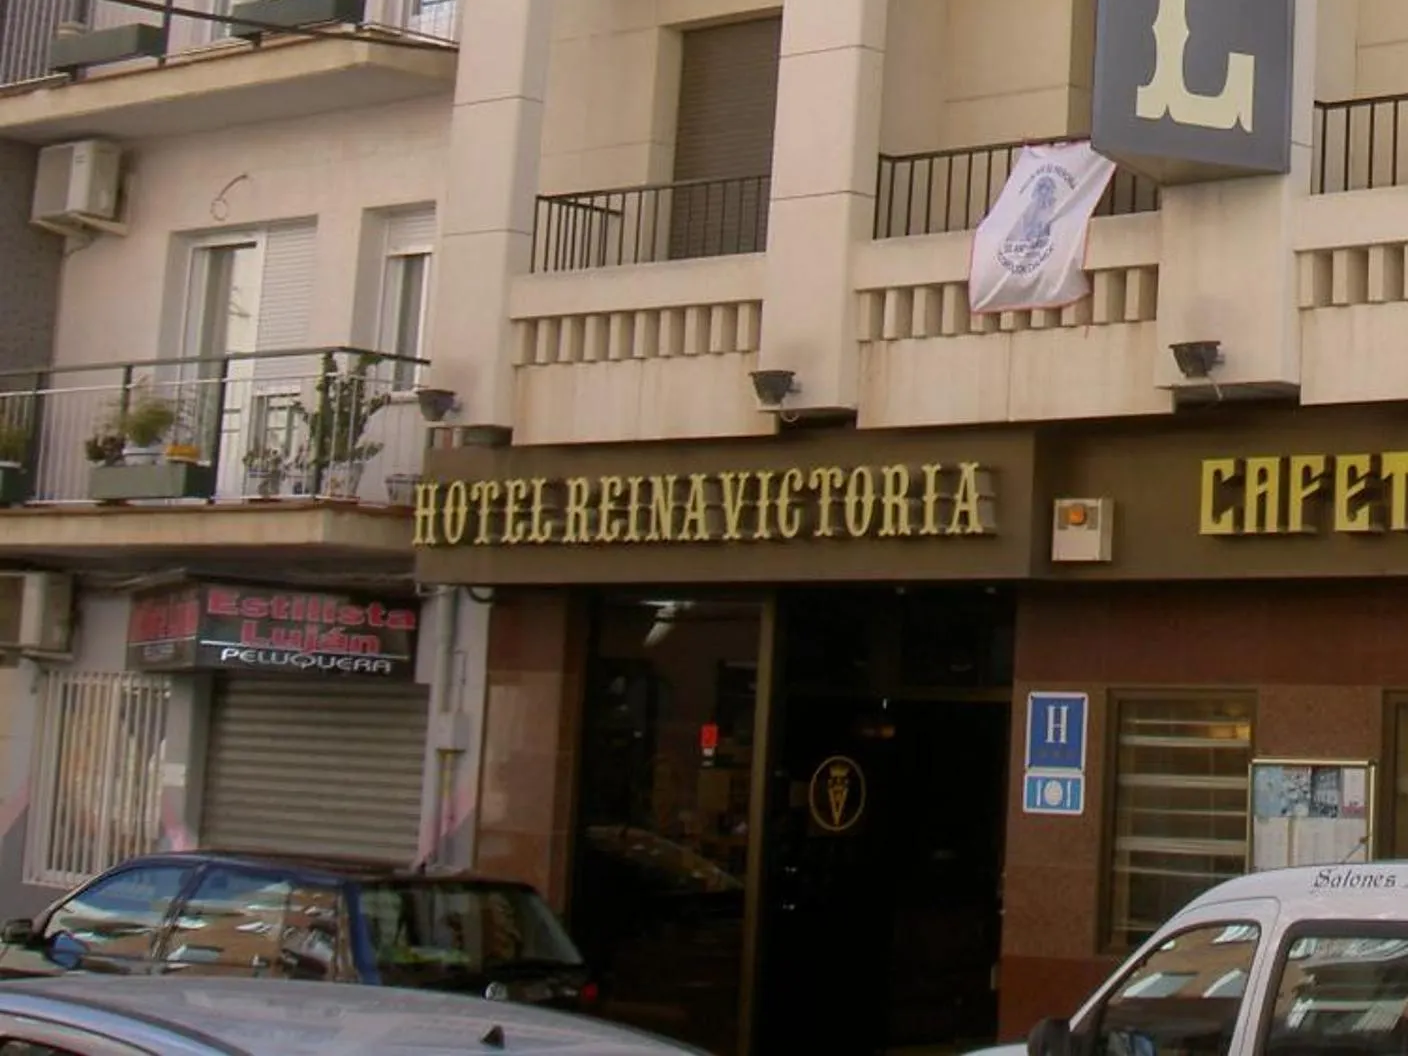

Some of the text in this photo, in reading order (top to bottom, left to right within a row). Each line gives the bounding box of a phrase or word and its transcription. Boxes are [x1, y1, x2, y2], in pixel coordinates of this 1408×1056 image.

[412, 461, 984, 544] HOTEL REINA VICTORIA
[206, 587, 416, 630] Estilista
[1044, 704, 1069, 744] H
[1312, 867, 1397, 889] Salones
